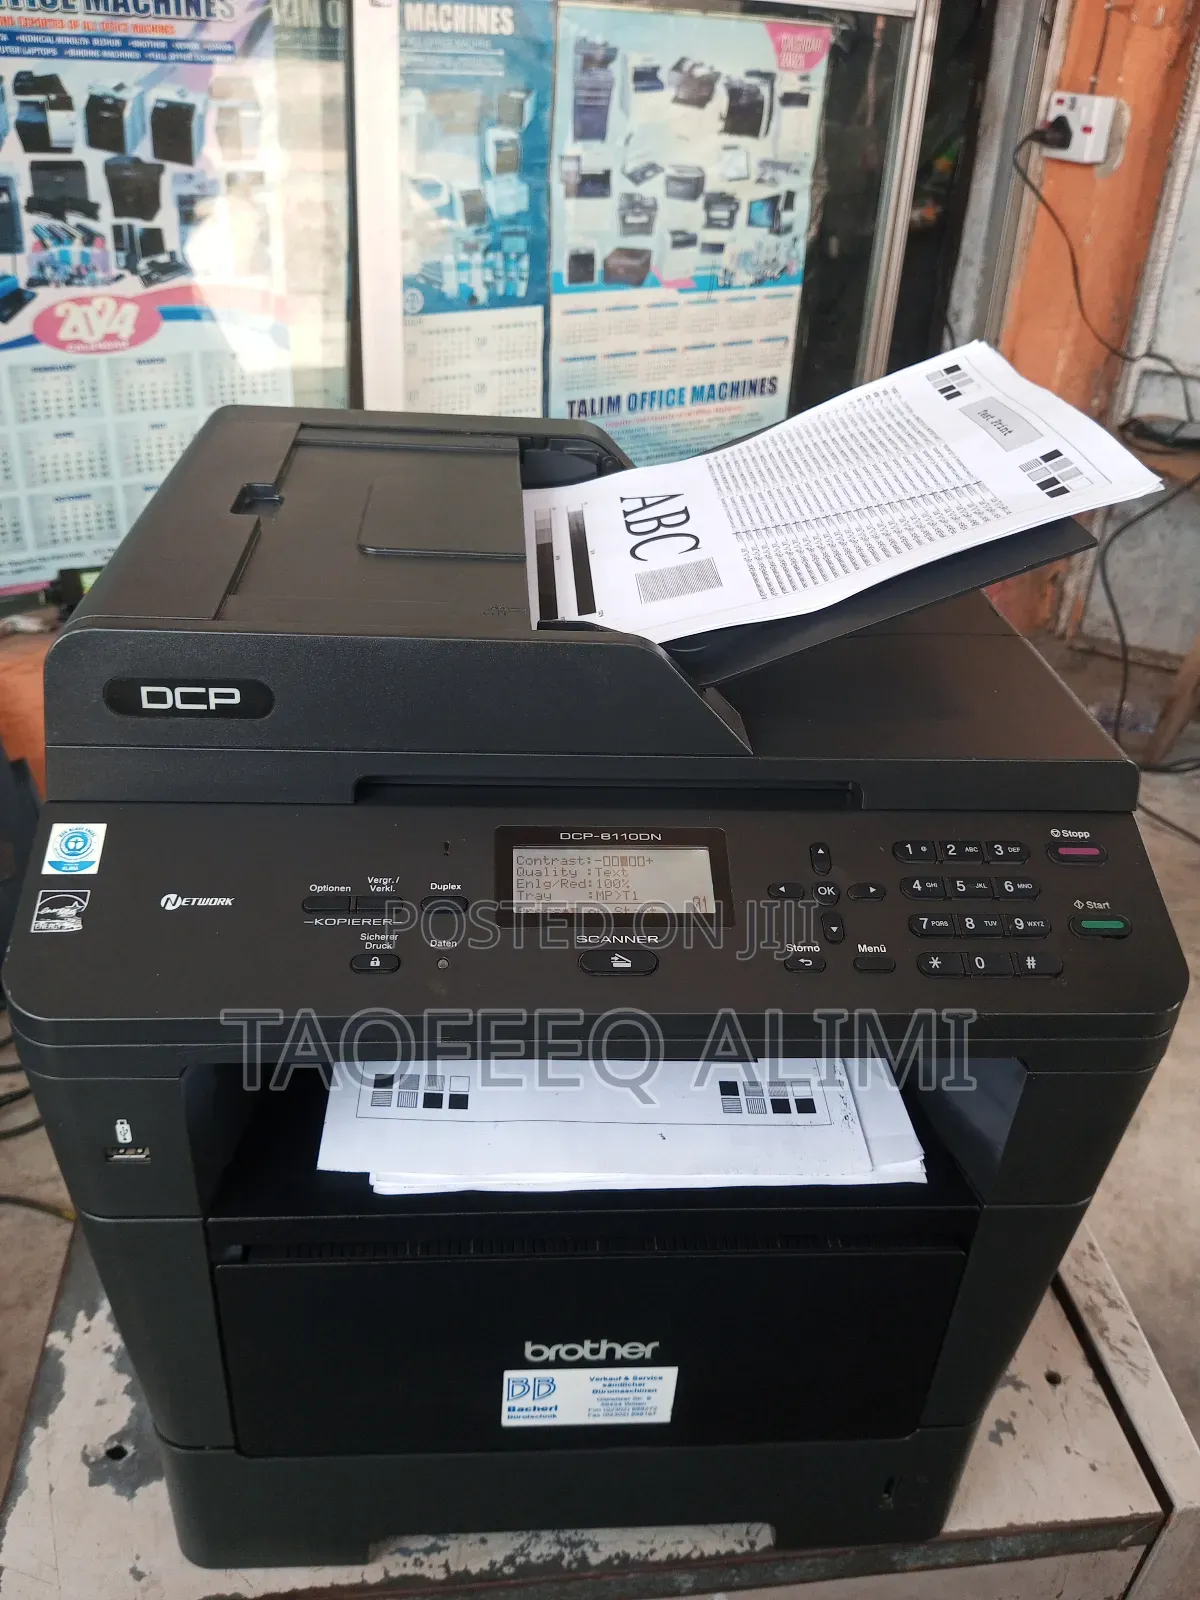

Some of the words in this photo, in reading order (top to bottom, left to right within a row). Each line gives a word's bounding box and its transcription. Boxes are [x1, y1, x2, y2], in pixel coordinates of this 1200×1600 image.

[403, 3, 515, 36] MACHINES
[54, 296, 139, 343] 2024
[567, 394, 621, 420] TALIM
[628, 386, 686, 412] OFFICE
[691, 376, 779, 405] MACHINES
[977, 409, 995, 421] Test
[619, 493, 703, 562] ABC
[140, 685, 241, 710] DCP
[559, 832, 662, 841] DCP-8110DN
[1061, 829, 1090, 839] Stopp
[906, 843, 913, 855] 1
[946, 843, 957, 856] 2
[994, 844, 1004, 856] 3
[516, 867, 578, 878] Quality
[309, 883, 352, 894] Optionen
[369, 884, 396, 894] Verkl.
[430, 882, 462, 893] Duplex
[817, 886, 836, 897] OK
[912, 880, 922, 892] 4
[956, 880, 966, 893] 5
[1004, 880, 1014, 893] 6
[161, 893, 235, 910] NETWORK
[517, 891, 552, 902] Tray
[1086, 901, 1111, 910] Start
[919, 917, 929, 930] 7
[965, 917, 976, 930] 8
[1014, 917, 1025, 930] 9
[1027, 920, 1045, 928] WXYZ
[360, 932, 399, 942] Sicherer
[577, 934, 659, 944] SCANNER
[365, 942, 393, 951] Druck
[430, 939, 457, 948] Daten
[786, 943, 820, 953] Storno
[975, 956, 985, 970] 0
[524, 1339, 660, 1362] brother
[507, 1377, 557, 1402] BB
